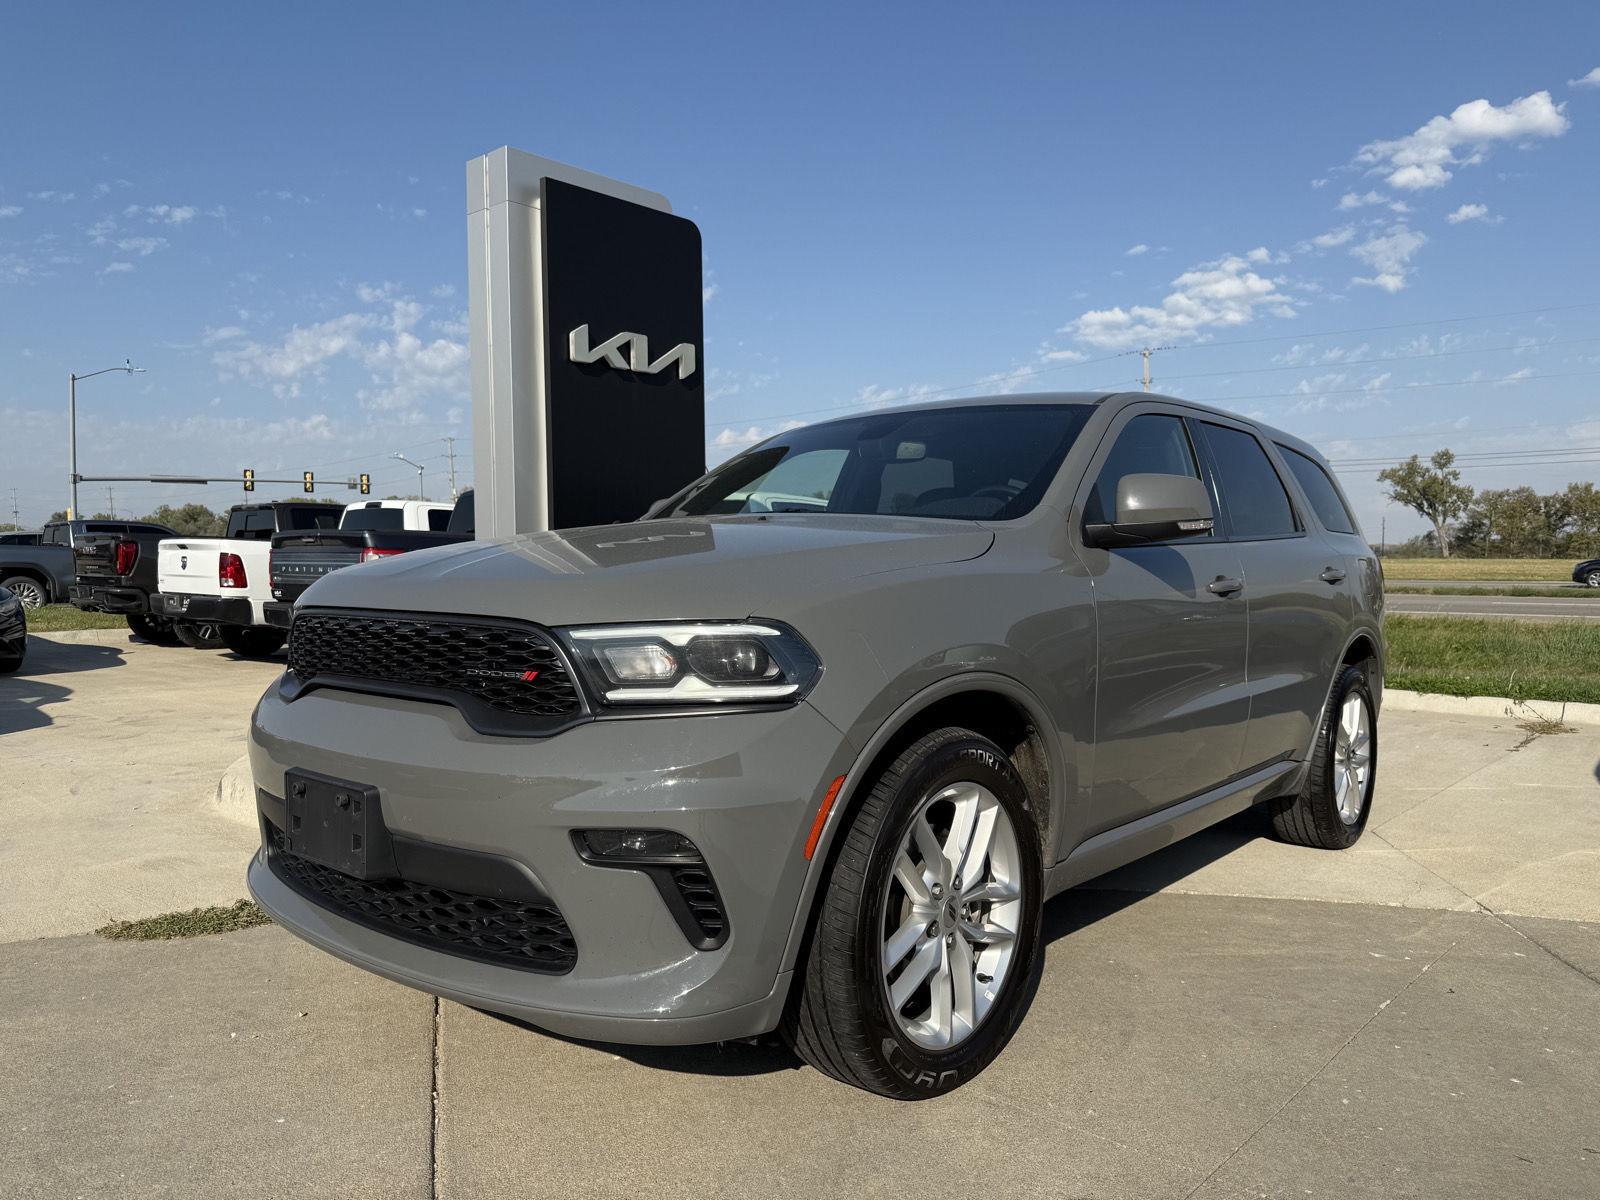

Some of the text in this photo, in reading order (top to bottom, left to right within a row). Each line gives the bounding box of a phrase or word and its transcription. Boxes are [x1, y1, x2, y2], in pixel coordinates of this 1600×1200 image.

[569, 323, 696, 380] KIA
[281, 566, 340, 574] PLATINU
[466, 668, 524, 679] DODGE
